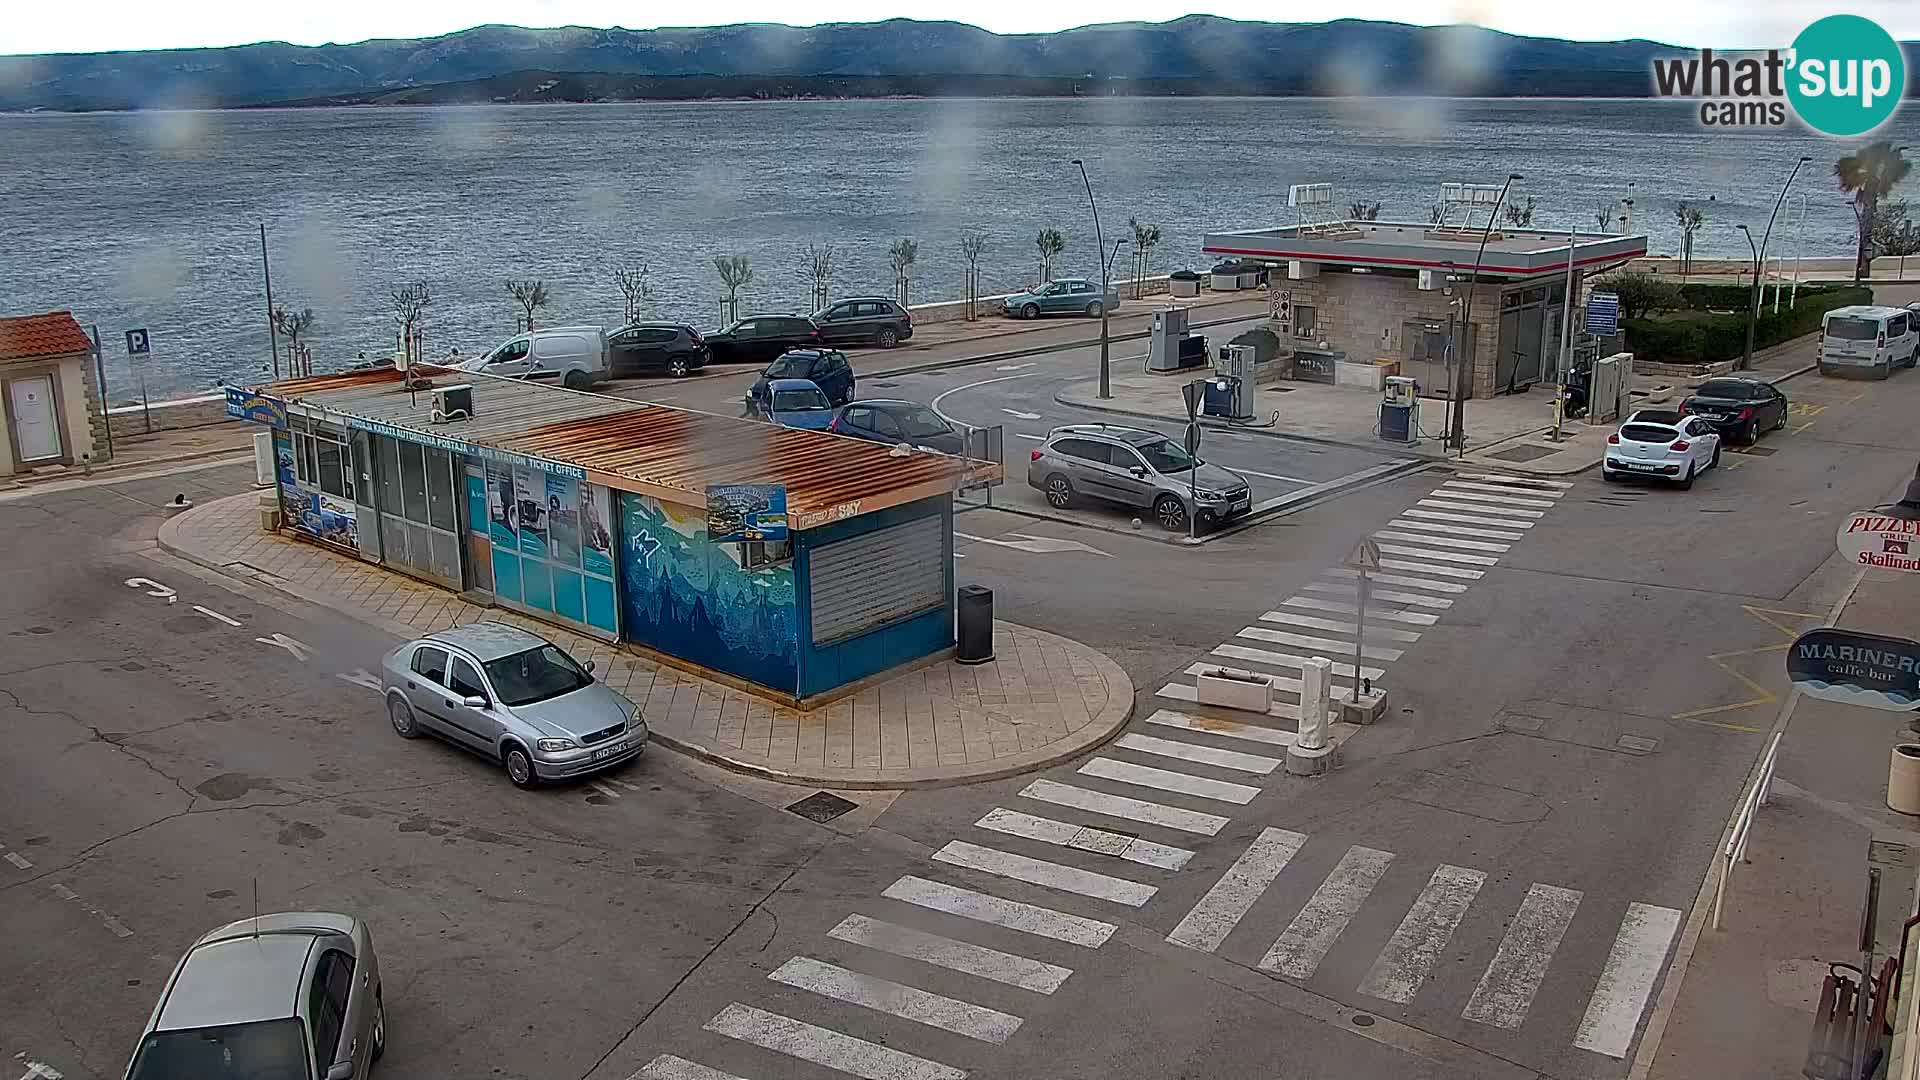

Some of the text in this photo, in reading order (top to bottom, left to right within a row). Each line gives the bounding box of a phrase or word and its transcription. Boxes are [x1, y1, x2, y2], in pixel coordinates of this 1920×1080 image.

[436, 437, 469, 452] POSTAJA
[494, 451, 527, 468] STATION
[528, 458, 555, 472] TICKET
[555, 464, 583, 478] OFFICE
[1880, 532, 1915, 543] GRILL
[1827, 663, 1896, 681] caffe bar
